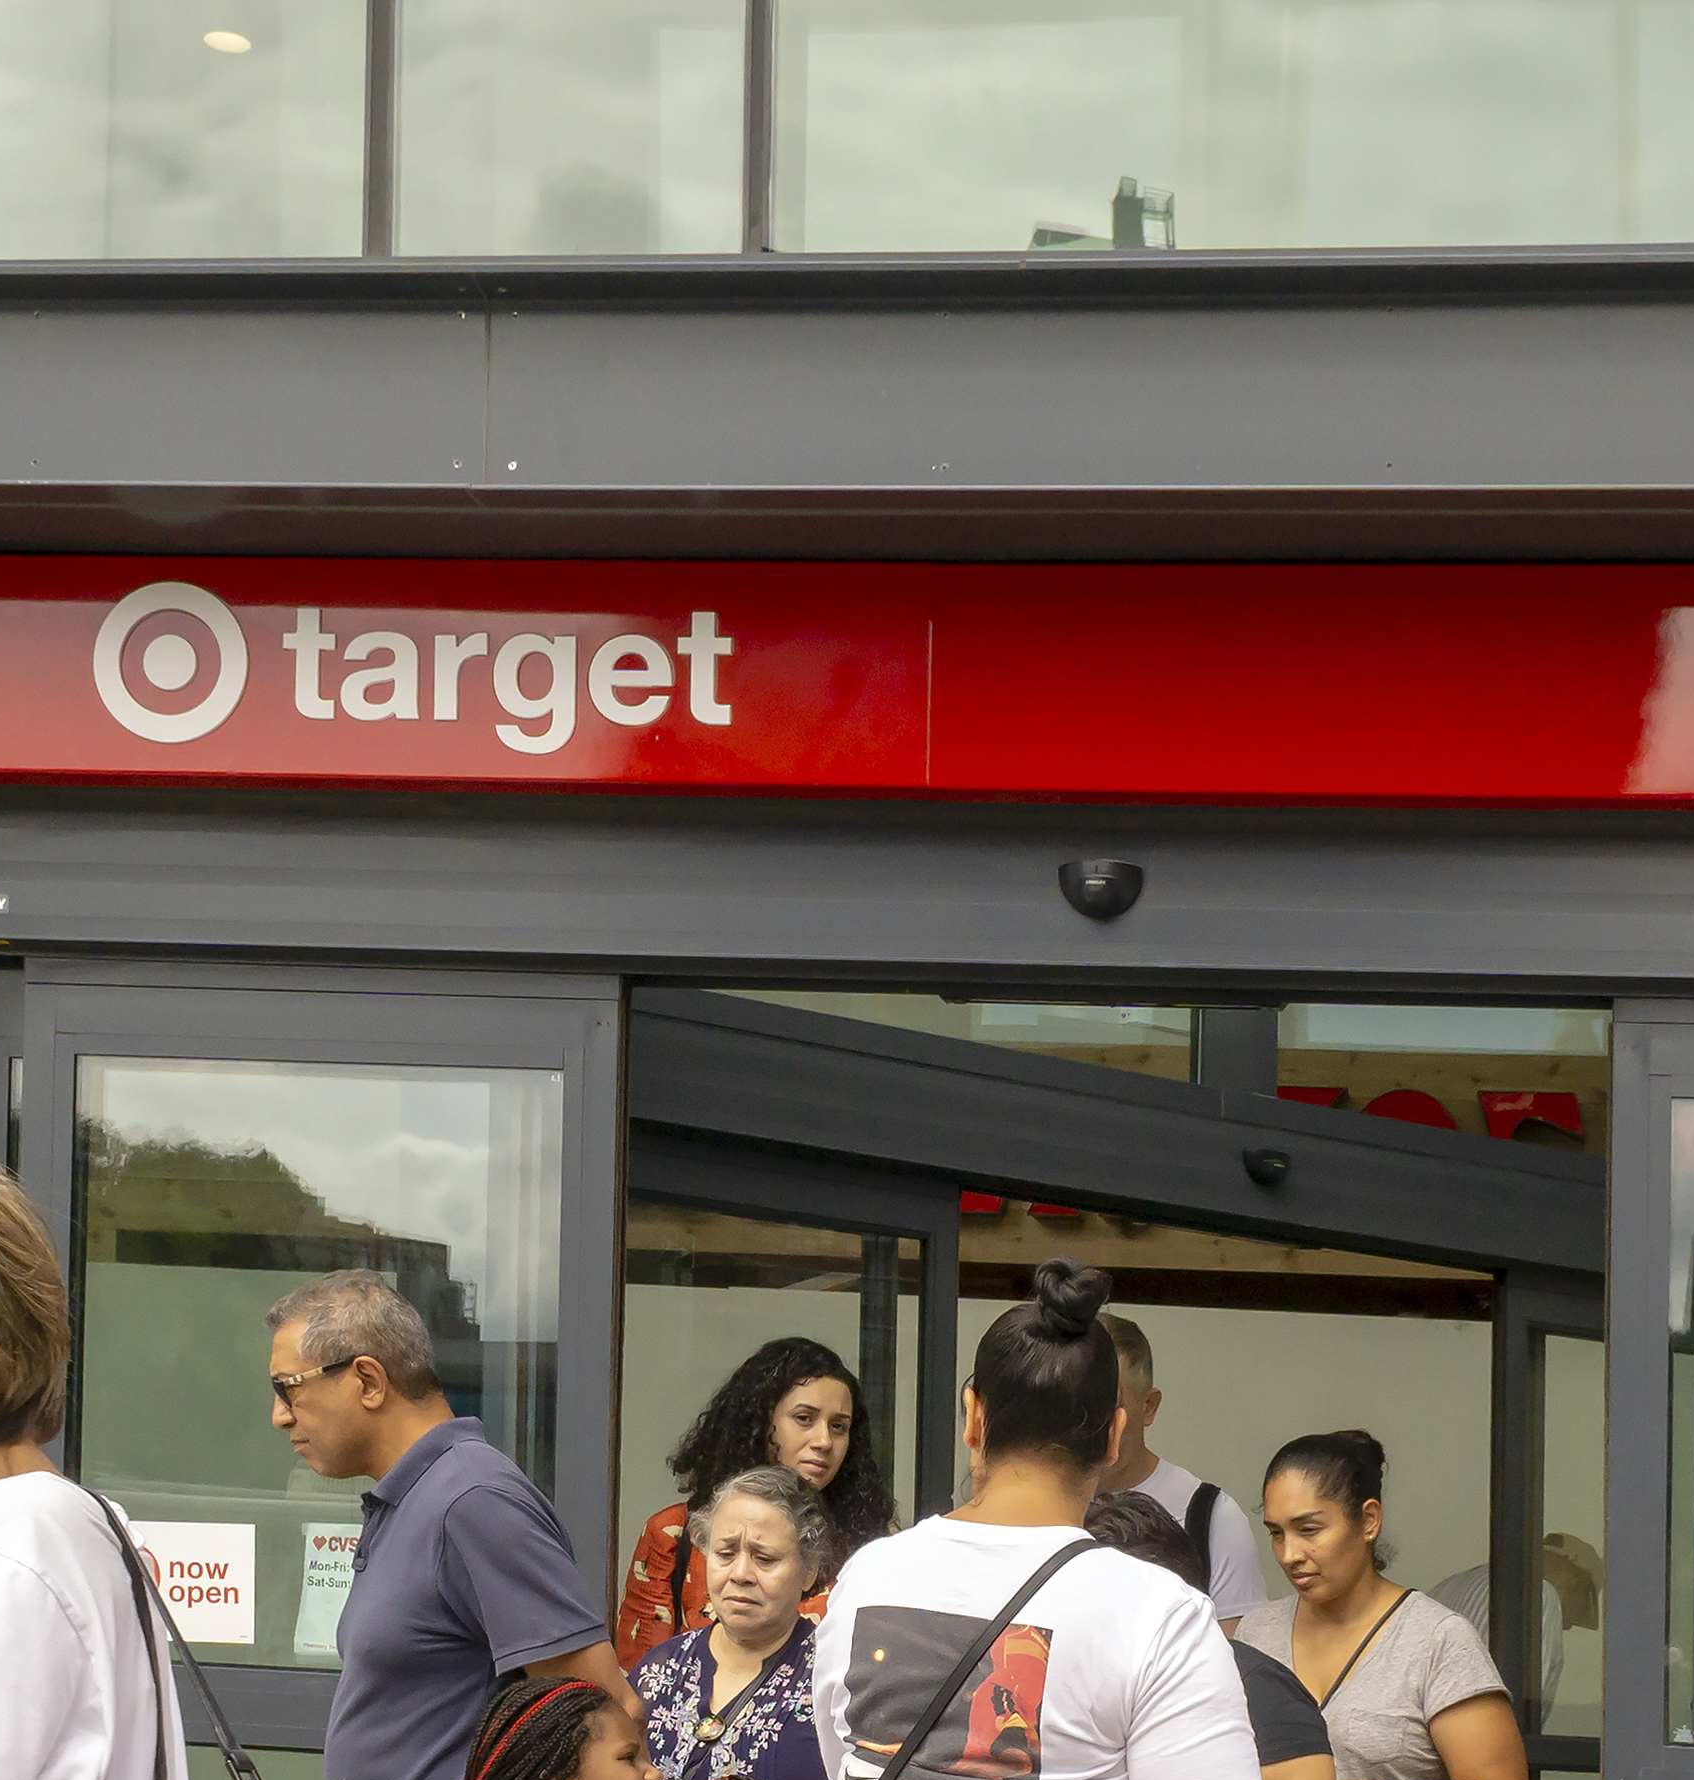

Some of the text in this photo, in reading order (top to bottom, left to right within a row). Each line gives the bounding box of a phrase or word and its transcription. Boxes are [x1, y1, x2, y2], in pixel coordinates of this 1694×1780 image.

[281, 606, 736, 755] target
[328, 1536, 359, 1553] CVS
[169, 1560, 229, 1580] now
[309, 1561, 350, 1573] Mon-Fri:
[307, 1576, 352, 1589] Sat-Sun:
[169, 1583, 240, 1608] open
